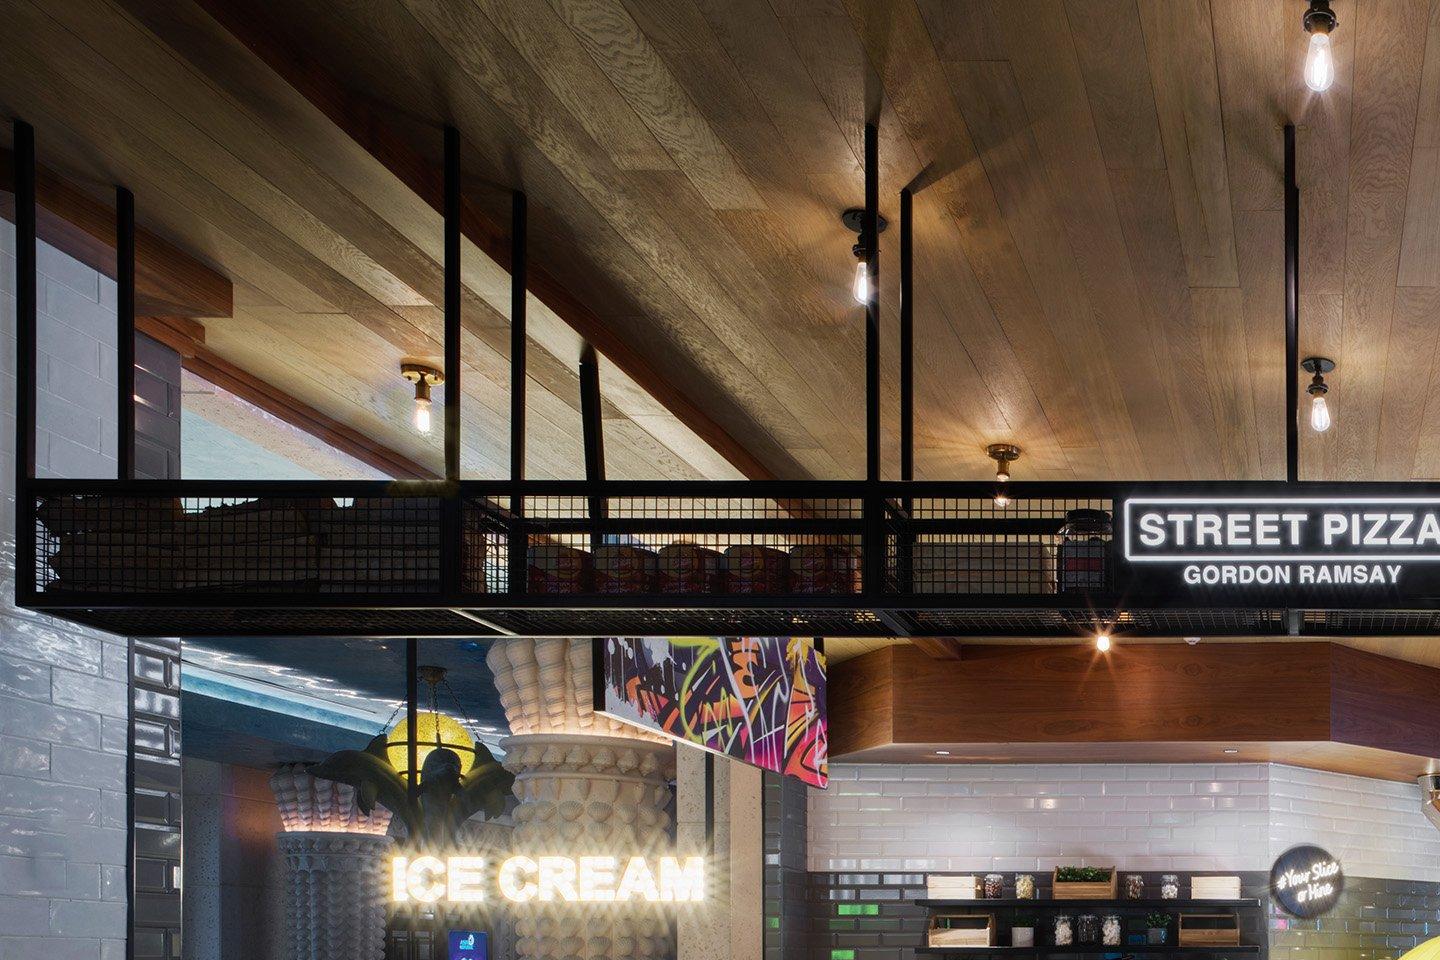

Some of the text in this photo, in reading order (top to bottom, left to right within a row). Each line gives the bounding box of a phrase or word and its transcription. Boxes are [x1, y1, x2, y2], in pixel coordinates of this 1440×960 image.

[1139, 513, 1308, 546] STREET
[1183, 564, 1402, 584] GORDON RAMSAY
[391, 855, 705, 902] ICE CREAM
[1277, 861, 1340, 889] #Your Slice
[1297, 890, 1308, 903] or
